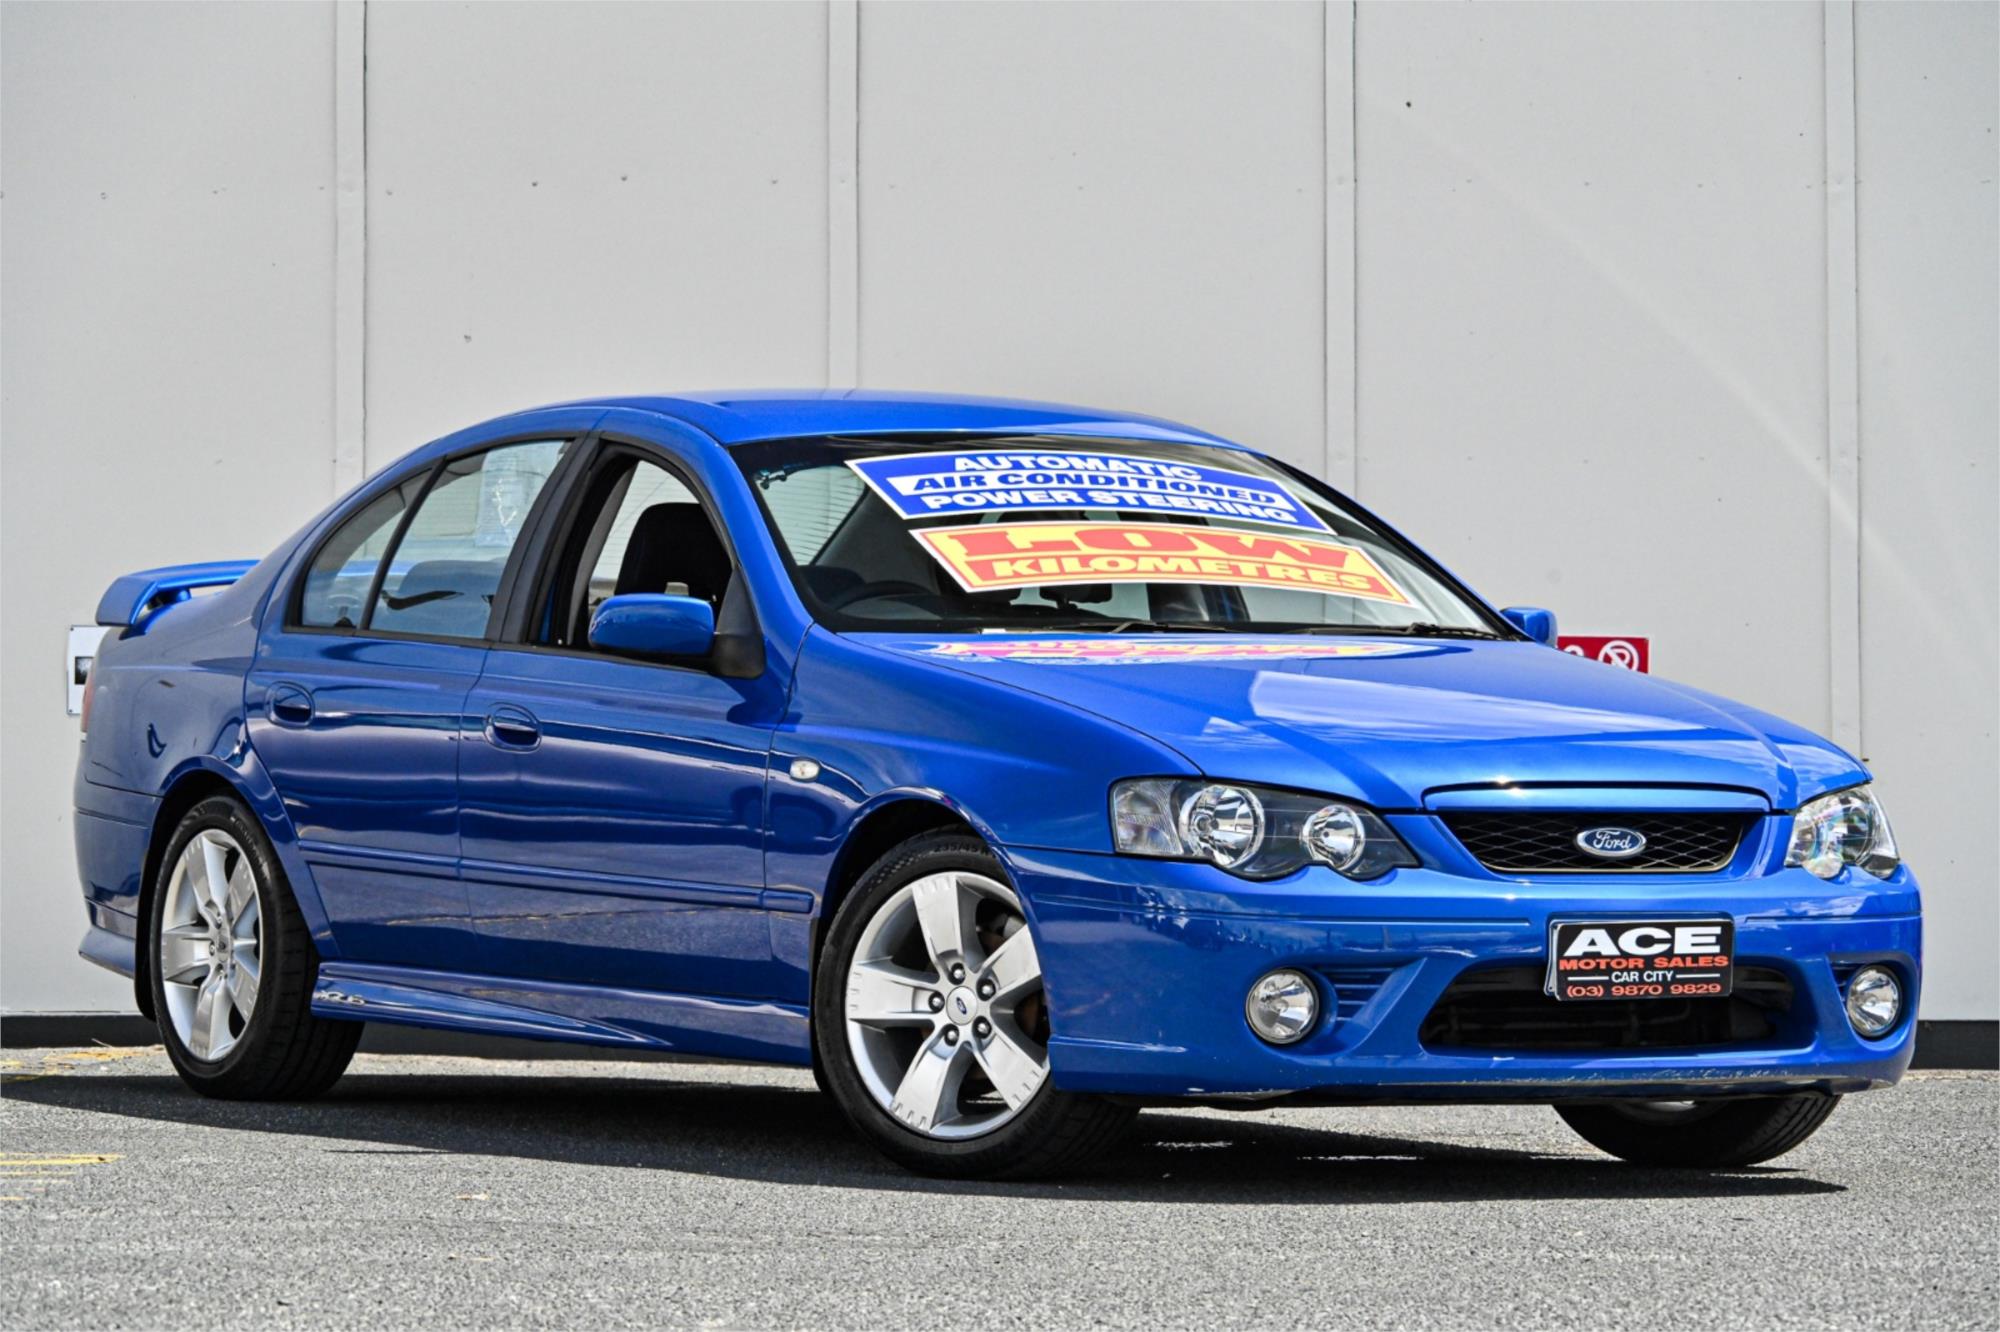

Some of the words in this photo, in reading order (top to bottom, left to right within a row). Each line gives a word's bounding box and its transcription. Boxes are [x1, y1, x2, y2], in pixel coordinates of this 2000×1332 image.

[955, 455, 1202, 482] AUTOMATIC
[913, 474, 988, 491] AIR
[997, 473, 1277, 504] CONDITIONED
[920, 490, 1086, 510] POWER
[1090, 490, 1299, 523] STEERING
[947, 528, 1350, 569] LOW
[991, 556, 1372, 590] KILOMETRES
[1592, 830, 1633, 849] Ford
[1562, 926, 1722, 957] ACE
[1559, 957, 1645, 971] MOTOR
[1653, 955, 1729, 969] SALES
[1611, 970, 1640, 983] CAR
[1643, 970, 1674, 983] CITY
[1566, 984, 1604, 999] (03)
[1611, 984, 1663, 997] 9870
[1670, 982, 1722, 996] 9829
